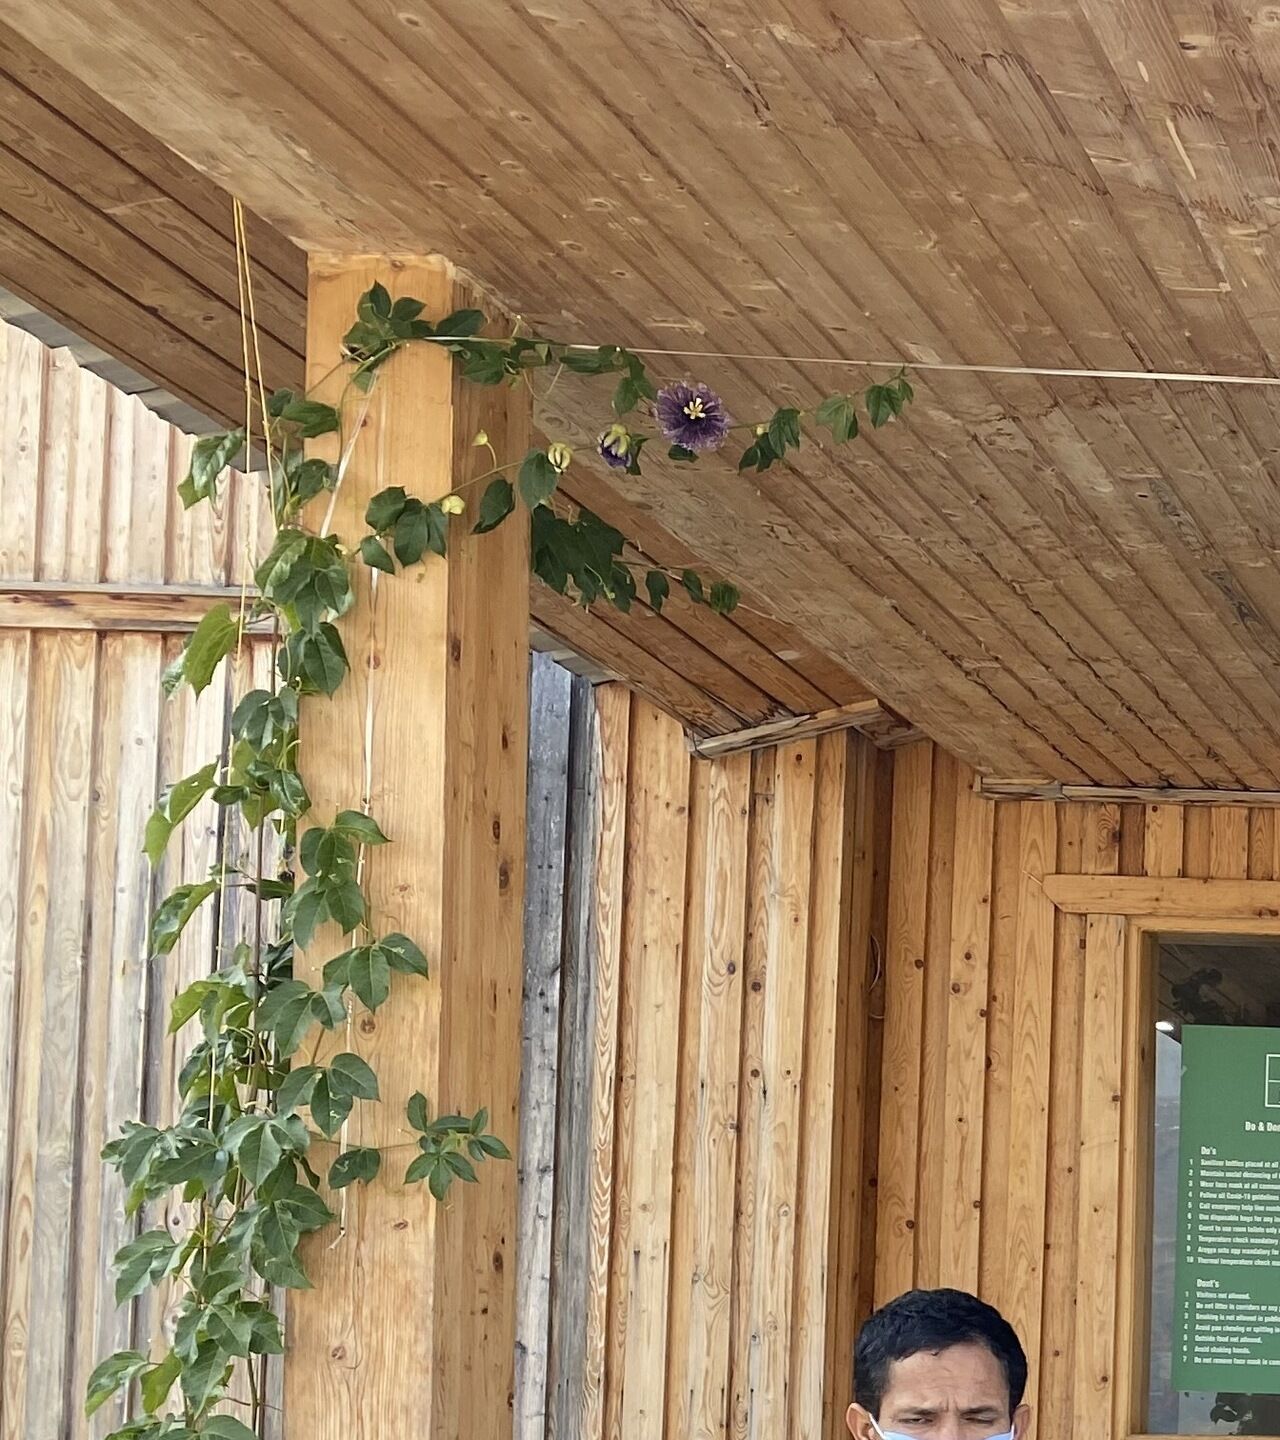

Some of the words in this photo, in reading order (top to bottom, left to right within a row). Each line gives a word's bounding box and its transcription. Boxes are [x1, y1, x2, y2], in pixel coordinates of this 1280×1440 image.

[1245, 1122, 1256, 1131] Do
[1258, 1122, 1265, 1132] &
[1201, 1146, 1216, 1155] Do's
[1197, 1279, 1219, 1288] Dont's
